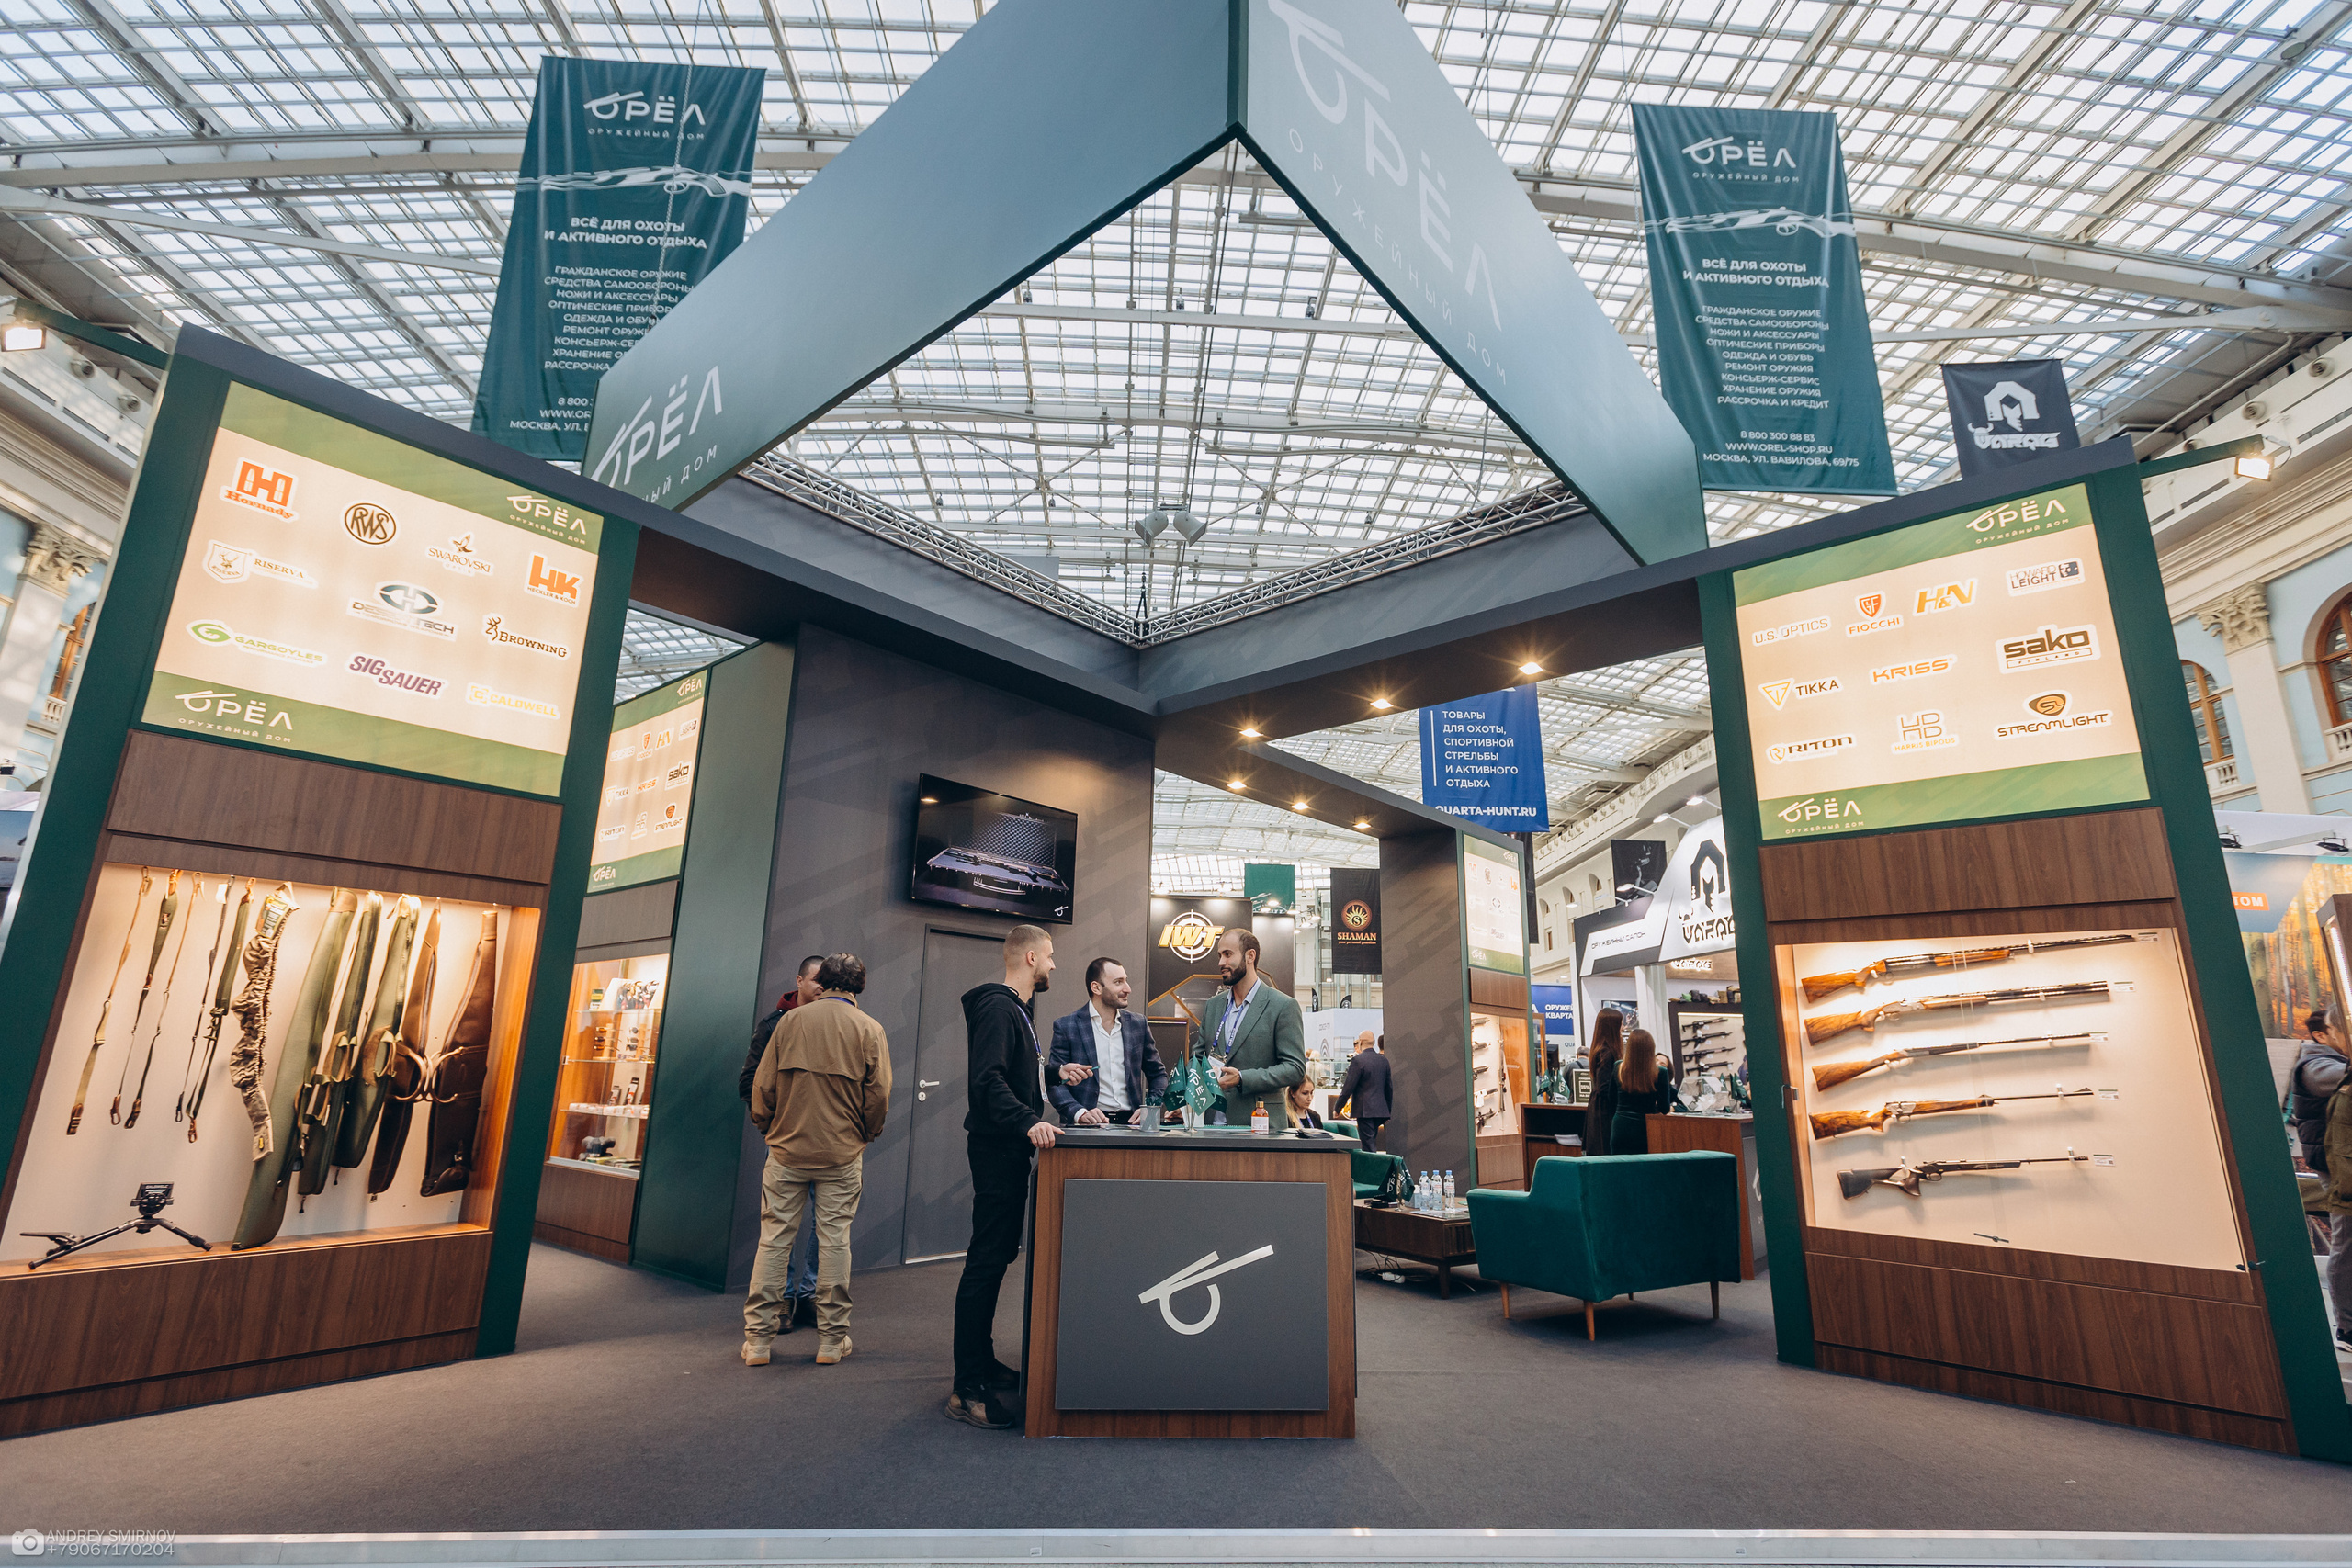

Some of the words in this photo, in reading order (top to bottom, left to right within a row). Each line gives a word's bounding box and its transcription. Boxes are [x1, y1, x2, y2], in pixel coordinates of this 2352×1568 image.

[587, 127, 670, 139] ОРУЖЕЙНЫЙ
[1691, 171, 1769, 182] ОРУЖЕЙНЫЙ
[1773, 175, 1801, 184] ДОМ
[570, 216, 599, 228] ВСЁ
[600, 219, 631, 231] ДЛЯ
[634, 220, 685, 233] ОХОТЫ
[544, 230, 555, 241] И
[557, 231, 644, 246] АКТИВНОГО
[646, 235, 707, 249] ОТДЫХА
[1288, 128, 1453, 326] ОРУЖЕЙНЫЙ
[1467, 331, 1507, 386] ДОМ
[554, 265, 639, 278] ГРАЖДАНСКОЕ
[639, 269, 687, 281] ОРУЖИЕ
[1702, 257, 1728, 270] ВСЁ
[1729, 260, 1758, 274] ДЛЯ
[1759, 260, 1807, 274] ОХОТЫ
[544, 276, 602, 288] СРЕДСТВА
[1682, 270, 1693, 281] И
[1694, 271, 1774, 286] АКТИВНОГО
[1774, 275, 1830, 288] ОТДЫХА
[556, 288, 592, 299] НОЖИ
[593, 290, 603, 300] И
[605, 290, 679, 303] АКСЕССУАРЫ
[548, 299, 624, 312] ОПТИЧЕСКИЕ
[625, 302, 673, 314] ПРИБОР
[1702, 304, 1777, 318] ГРАЖДАНСКОЕ
[1778, 308, 1822, 319] ОРУЖИЕ
[563, 312, 613, 325] ОДЕЖДА
[614, 314, 624, 323] И
[1695, 314, 1747, 327] СРЕДСТВА
[1748, 318, 1830, 331] САМООБОРОНЫ
[562, 324, 609, 336] РЕМОНТ
[1709, 327, 1741, 338] НОЖИ
[1742, 329, 1751, 338] И
[1752, 329, 1820, 340] АКСЕССУАРЫ
[1706, 337, 1773, 350] ОПТИЧЕСКИЕ
[1774, 341, 1826, 353] ПРИБОРЫ
[551, 347, 613, 360] ХРАНЕНИЕ
[1722, 350, 1768, 362] ОДЕЖДА
[1769, 352, 1778, 361] И
[1778, 353, 1814, 363] ОБУВЬ
[544, 360, 611, 372] РАССРОЧКА
[1724, 362, 1768, 373] РЕМОНТ
[1769, 363, 1814, 373] ОРУЖИЯ
[1721, 372, 1821, 386] КОНСЬЕРЖ-СЕРВИС
[1722, 384, 1778, 396] ХРАНЕНИЕ
[1778, 386, 1821, 398] ОРУЖИЯ
[557, 396, 566, 406] 8
[566, 396, 589, 407] 800
[1717, 395, 1780, 407] РАССРОЧКА
[1780, 397, 1789, 407] И
[1790, 398, 1830, 410] КРЕДИТ
[509, 419, 561, 432] МОСКВА,
[562, 422, 582, 432] УЛ.
[1739, 430, 1748, 440] 8
[1748, 430, 1769, 441] 800
[1769, 431, 1789, 442] 300
[1724, 442, 1834, 455] WWW.OREL-SHOP.RU
[680, 444, 718, 485] ДОМ
[1702, 453, 1751, 464] МОСКВА,
[1752, 454, 1770, 464] УЛ.
[1770, 455, 1832, 467] ВАВИЛОВА,
[1832, 457, 1860, 468] 69/75
[224, 489, 294, 520] Hornady
[350, 505, 390, 541] RWS
[509, 514, 564, 537] ОРУЖЕЙНЫЙ
[567, 535, 586, 545] ДОМ
[1975, 524, 2041, 545] ОРУЖЕЙНЫЙ
[2046, 517, 2069, 530] ДОМ
[427, 547, 491, 573] SWAROVSKI
[254, 558, 304, 579] RISERVA
[2011, 571, 2057, 589] LEIGHT
[526, 585, 555, 600] HECKLER
[560, 595, 576, 605] KOCH
[1916, 580, 1974, 615] H&N
[1754, 630, 1778, 645] U.S.
[1781, 618, 1829, 637] OPTICS
[1849, 616, 1901, 636] FIOCCHI
[234, 636, 323, 662] GARGOYLES
[348, 654, 386, 676] SIG
[1872, 658, 1949, 682] KRISS
[378, 669, 443, 696] SAUER
[1795, 679, 1839, 696] TIKKA
[490, 693, 557, 717] CALDWELL
[1442, 710, 1486, 720] ТОВАРЫ
[177, 717, 259, 738] ОРУЖЕЙНЫЙ
[265, 733, 291, 743] ДОМ
[1442, 724, 1464, 734] ДЛЯ
[1466, 725, 1507, 736] ОХОТЫ,
[1997, 712, 2109, 738] STREAMLIGHT
[1443, 737, 1514, 748] СПОРТИВНОЙ
[1894, 742, 1924, 751] HARRIS
[1925, 737, 1956, 748] BIPODS
[1444, 751, 1499, 761] СТРЕЛЬБЫ
[1445, 764, 1453, 773] И
[1455, 765, 1519, 774] АКТИВНОГО
[1445, 779, 1491, 789] ОТДЫХА
[1434, 805, 1537, 817] QUARTA-HUNT.RU
[1785, 823, 1840, 835] ОРУЖЕЙНЫЙ
[1845, 820, 1865, 829] ДОМ
[1158, 924, 1225, 948] IWT
[1337, 931, 1377, 941] SHAMAN
